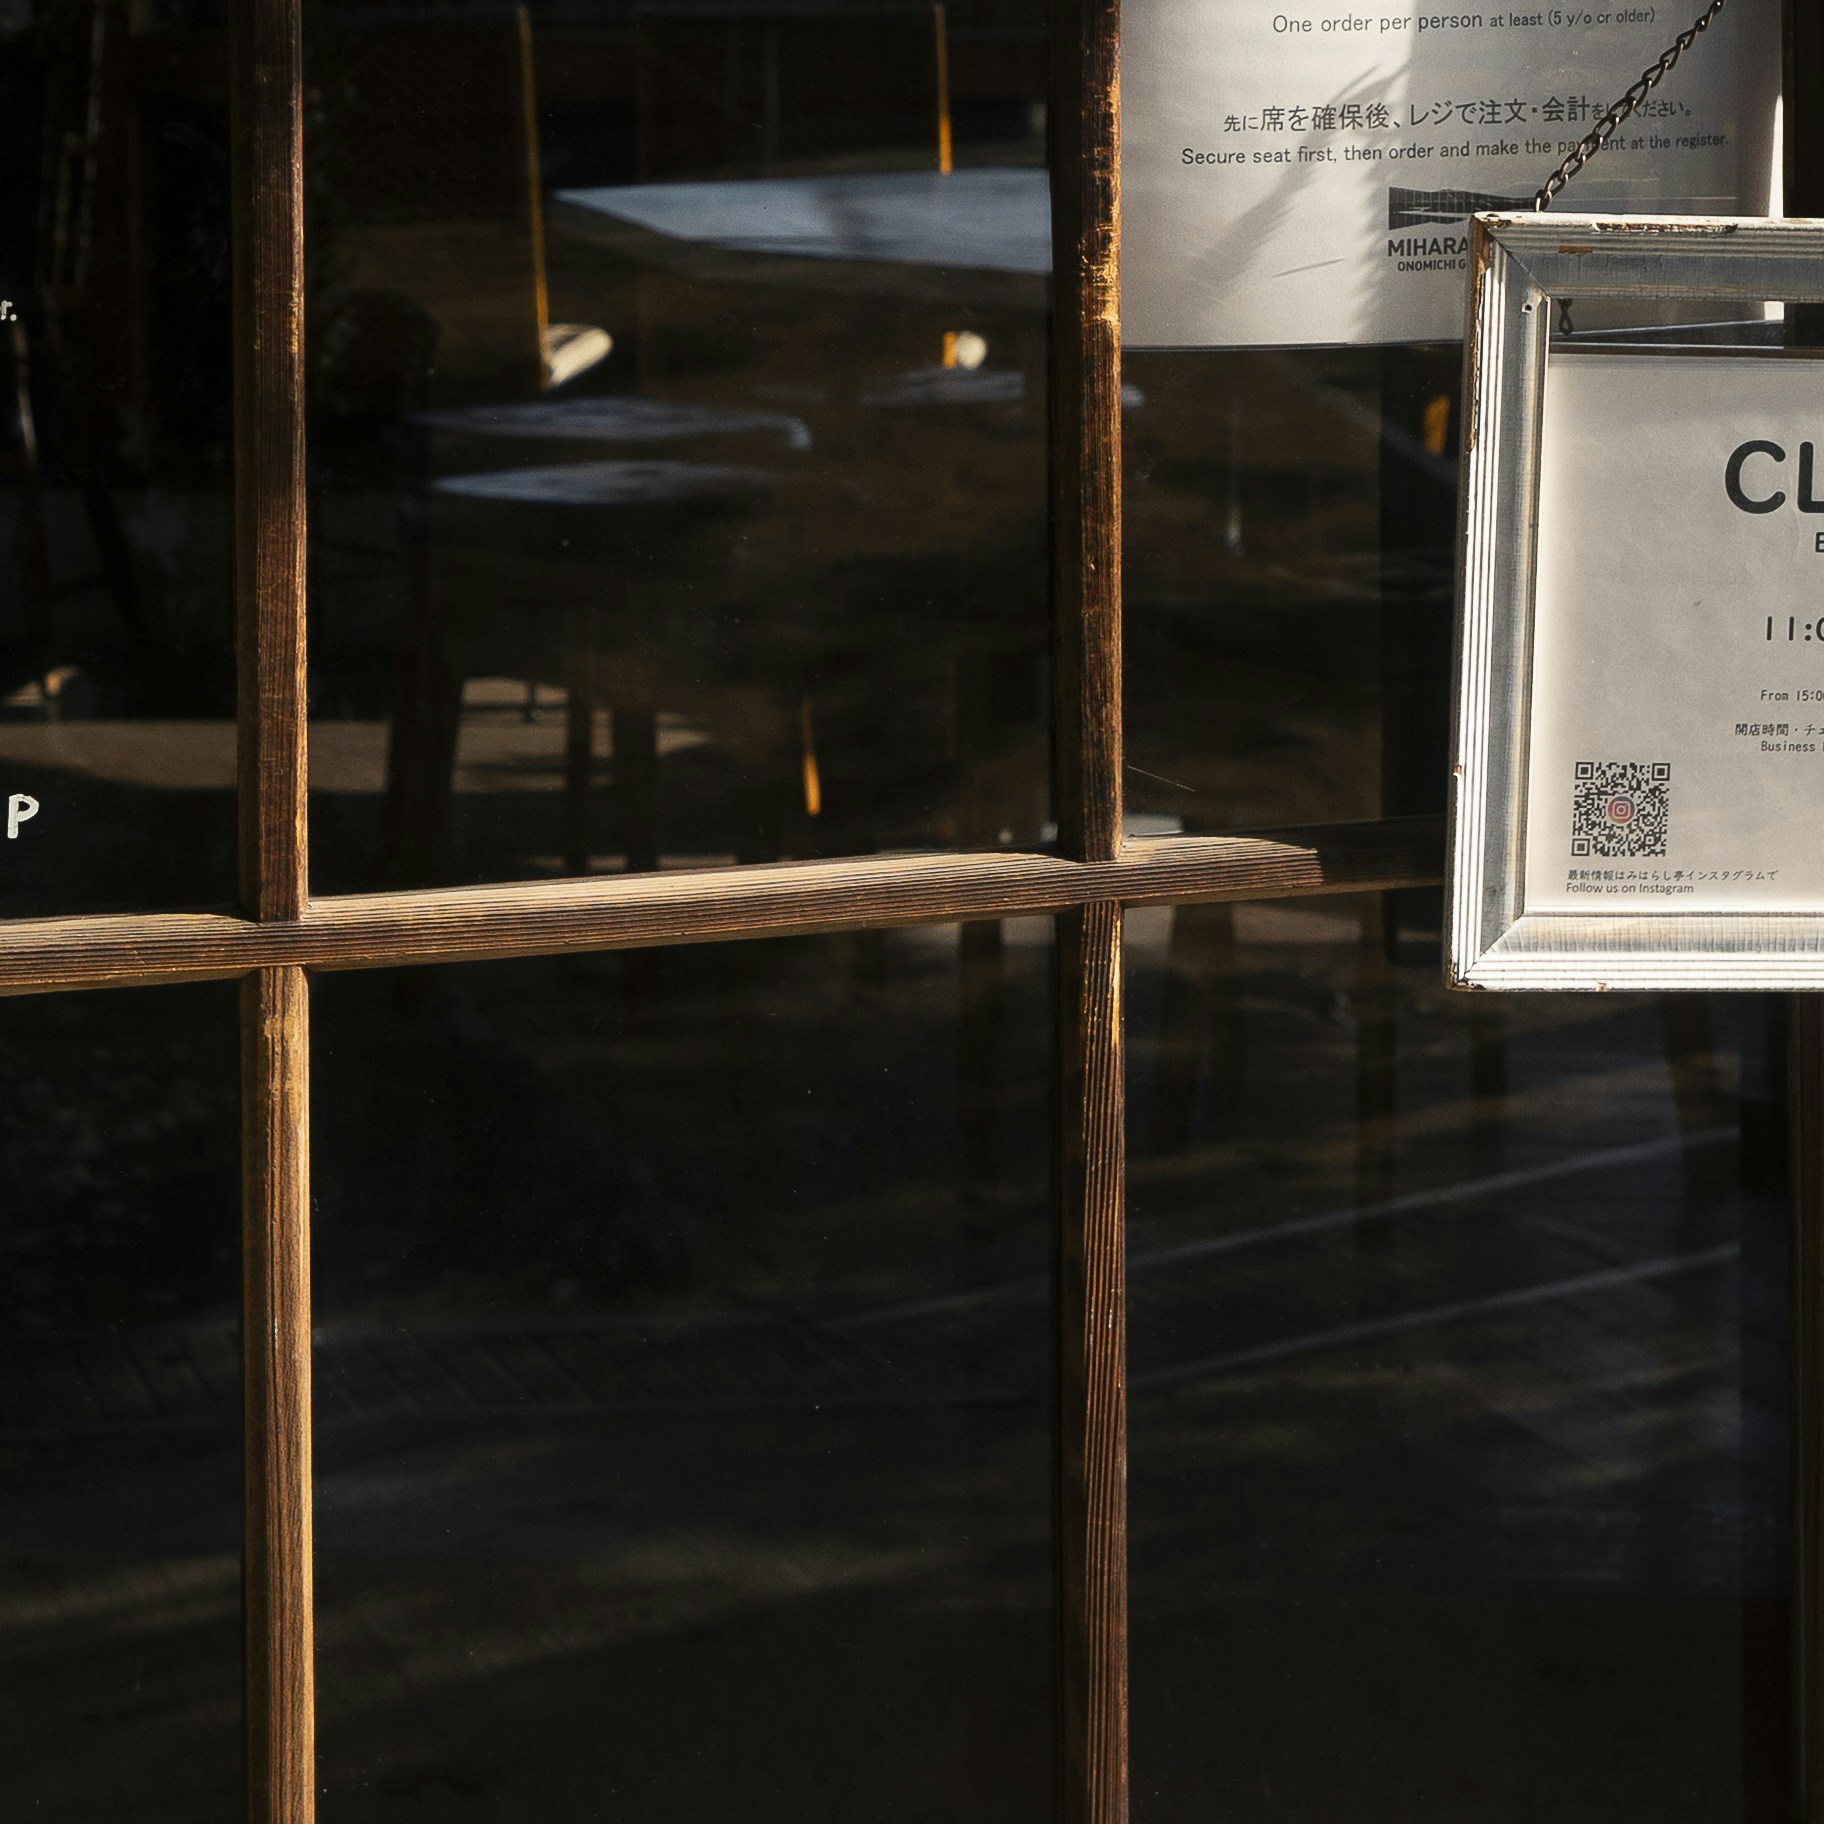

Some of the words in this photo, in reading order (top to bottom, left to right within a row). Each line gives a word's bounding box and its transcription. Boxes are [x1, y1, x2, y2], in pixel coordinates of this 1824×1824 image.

[1273, 14, 1312, 33] One
[1321, 13, 1372, 33] order
[1379, 15, 1410, 34] per
[1418, 13, 1483, 31] person
[1489, 14, 1505, 28] at
[1509, 12, 1543, 27] least
[1548, 10, 1562, 27] (5
[1566, 10, 1592, 27] y/o
[1598, 12, 1611, 23] or
[1616, 8, 1655, 25] older)
[1182, 147, 1245, 165] Secure
[1253, 148, 1290, 163] seat
[1298, 146, 1337, 164] first,
[1344, 145, 1382, 161] then
[1389, 143, 1434, 159] order
[1440, 141, 1470, 157] and
[1476, 139, 1519, 156] make
[1526, 138, 1550, 154] the
[1631, 136, 1644, 150] at
[1649, 134, 1670, 149] the
[1676, 133, 1729, 149] register.
[1388, 237, 1468, 256] MIHARA
[1397, 259, 1455, 272] ONOMICHI
[1760, 689, 1789, 702] From
[1761, 740, 1816, 753] Business
[1567, 869, 1778, 882] 最新情報はみはらし亭インスタグラムで
[1566, 883, 1603, 894] Follow
[1606, 885, 1619, 894] us
[1621, 885, 1636, 894] on
[1639, 883, 1694, 895] Instagram
